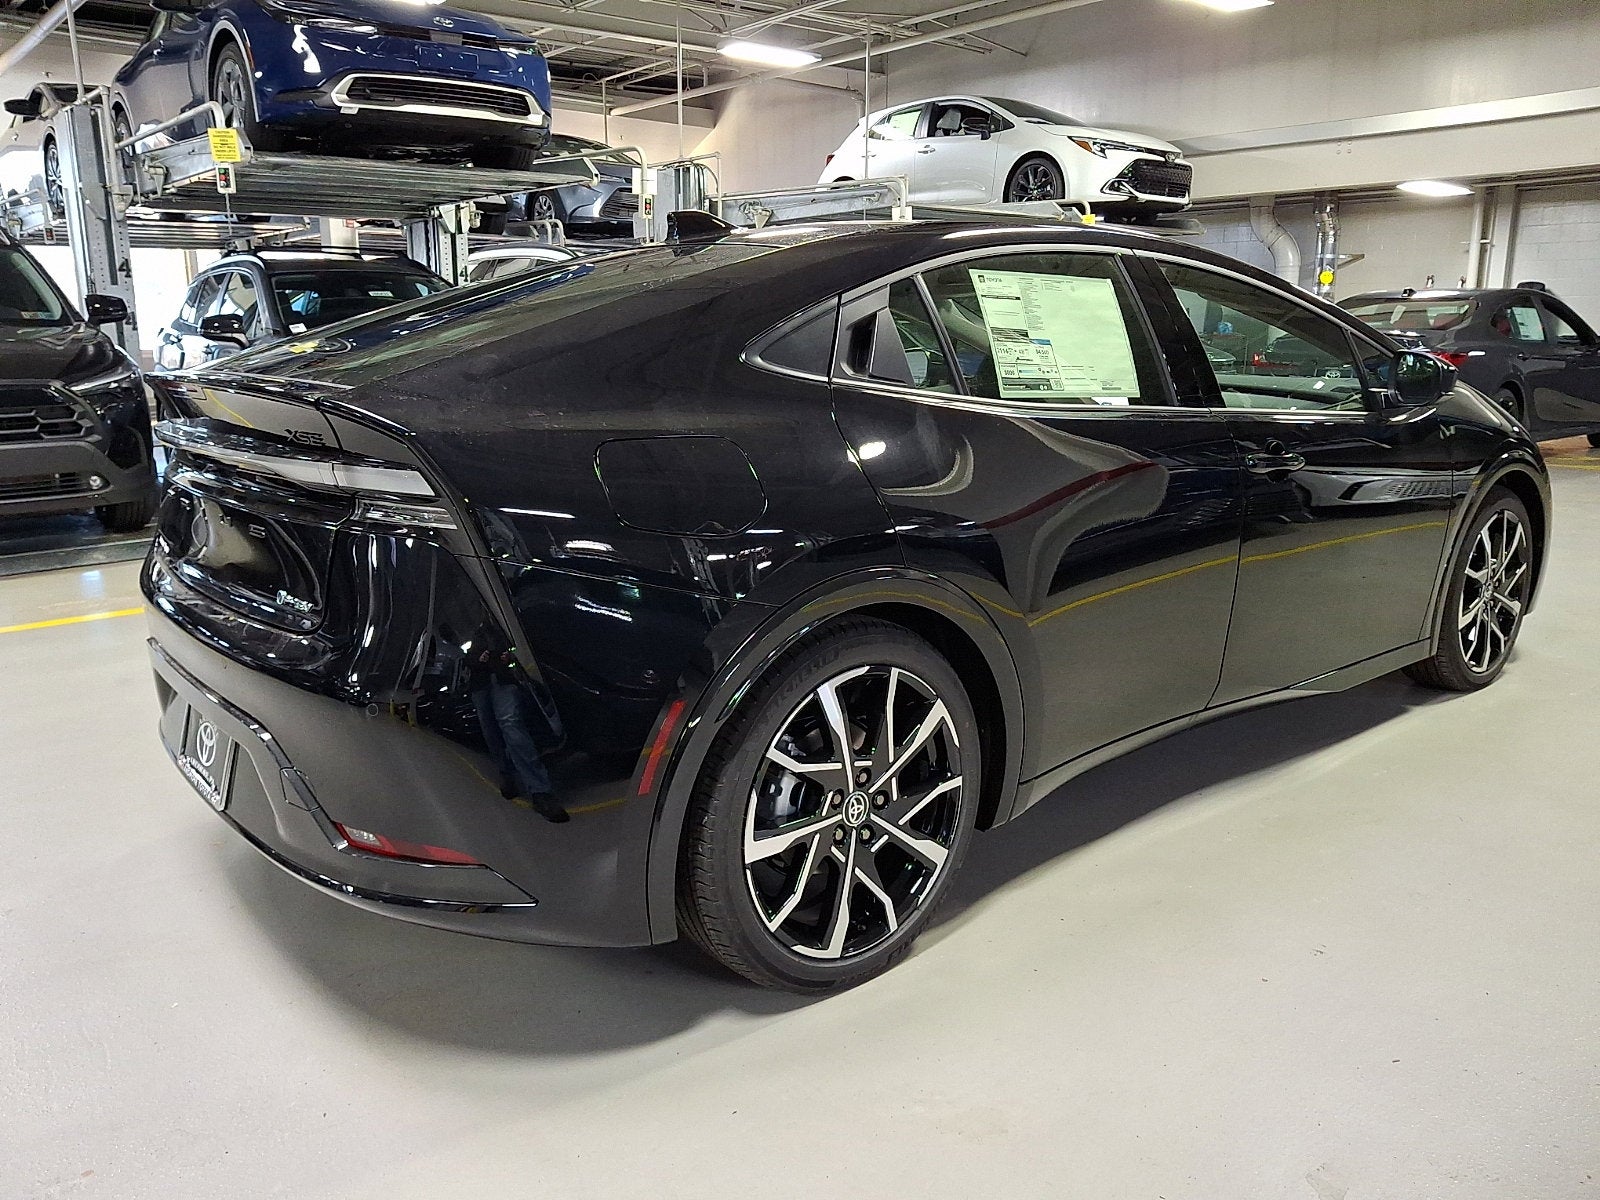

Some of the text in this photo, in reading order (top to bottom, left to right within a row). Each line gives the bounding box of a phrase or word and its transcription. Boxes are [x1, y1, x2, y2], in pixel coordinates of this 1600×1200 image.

[118, 257, 132, 278] 4
[459, 265, 469, 282] 4
[284, 428, 327, 447] XSE
